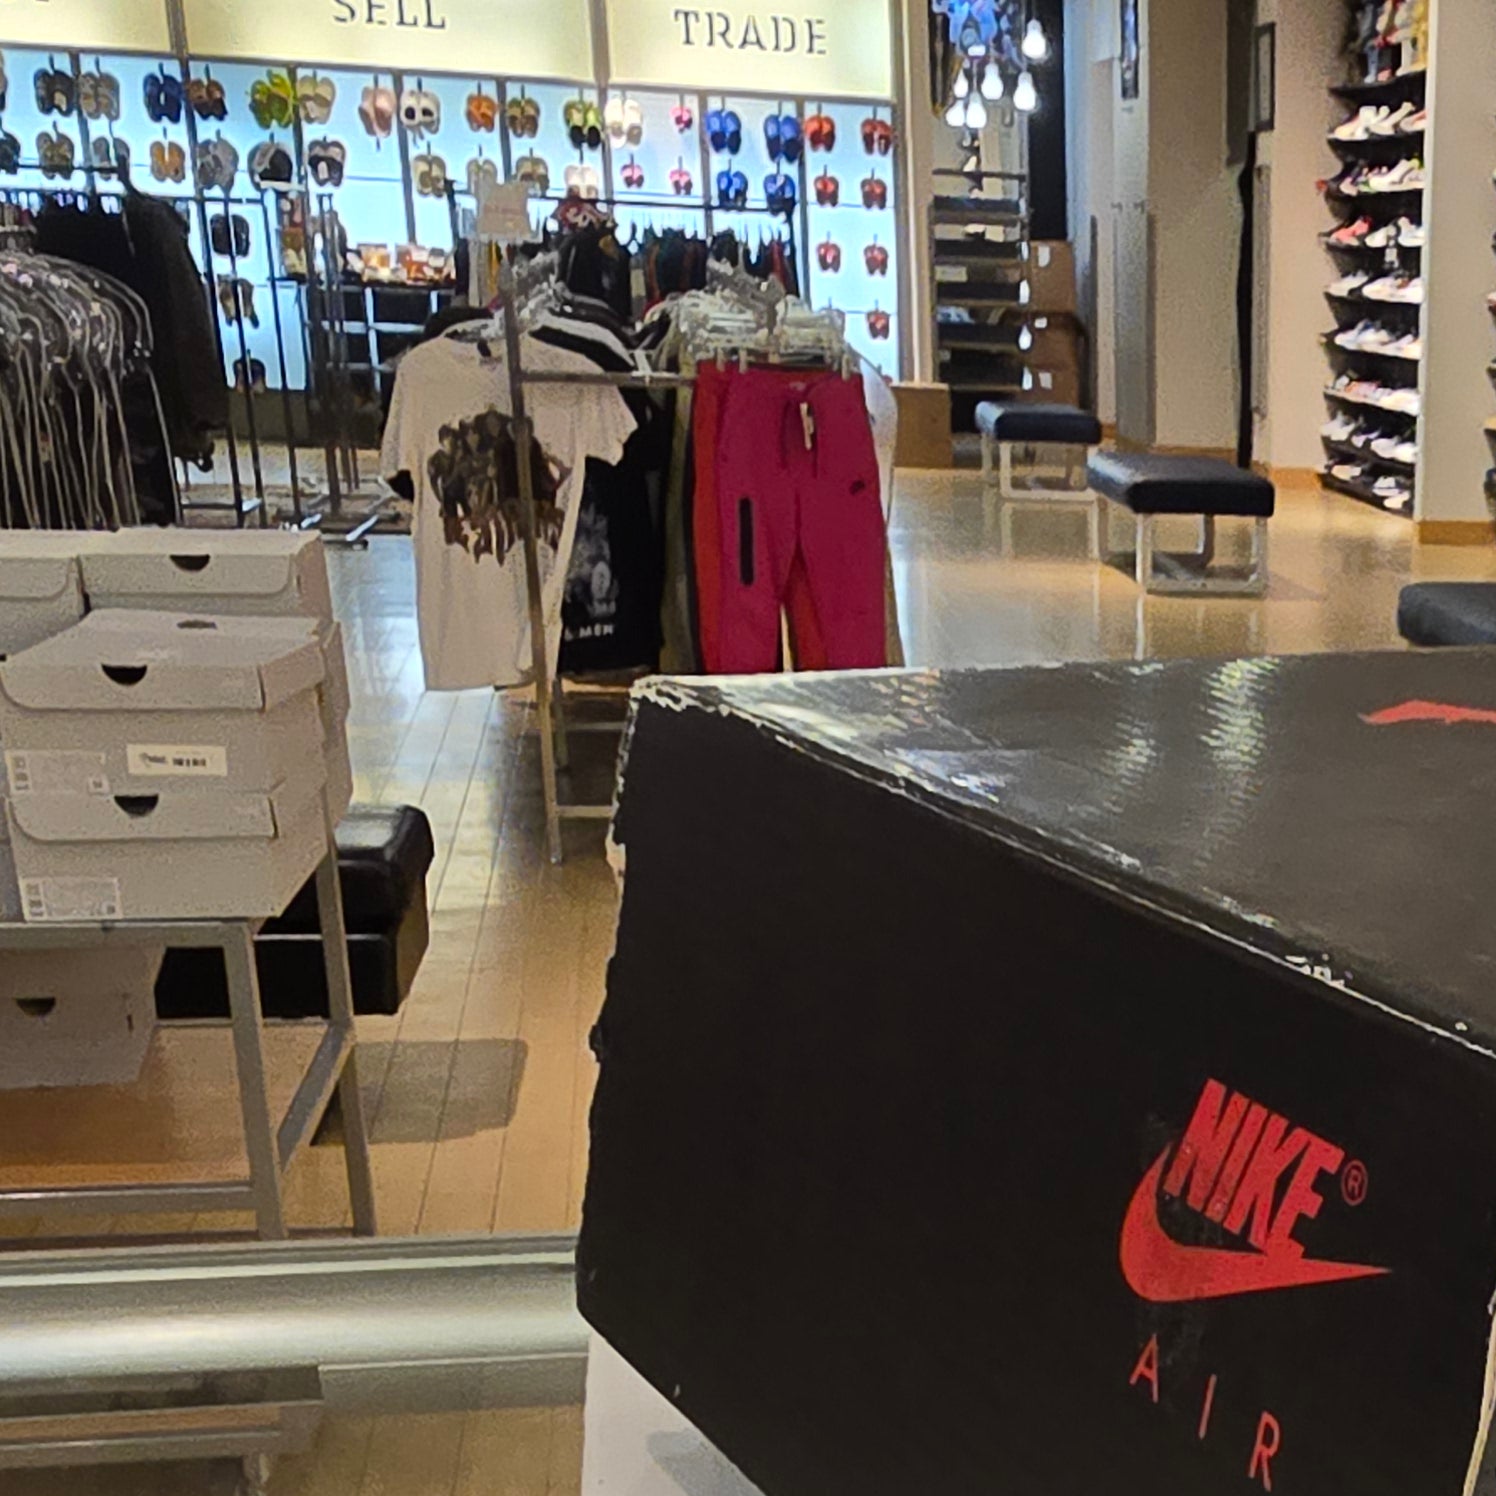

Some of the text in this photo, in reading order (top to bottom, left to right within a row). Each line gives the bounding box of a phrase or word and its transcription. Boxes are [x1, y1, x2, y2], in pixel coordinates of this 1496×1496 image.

[332, 0, 446, 29] SELL
[674, 9, 827, 55] TRADE
[1163, 1078, 1345, 1259] NIKE
[1129, 1333, 1281, 1493] AIR
